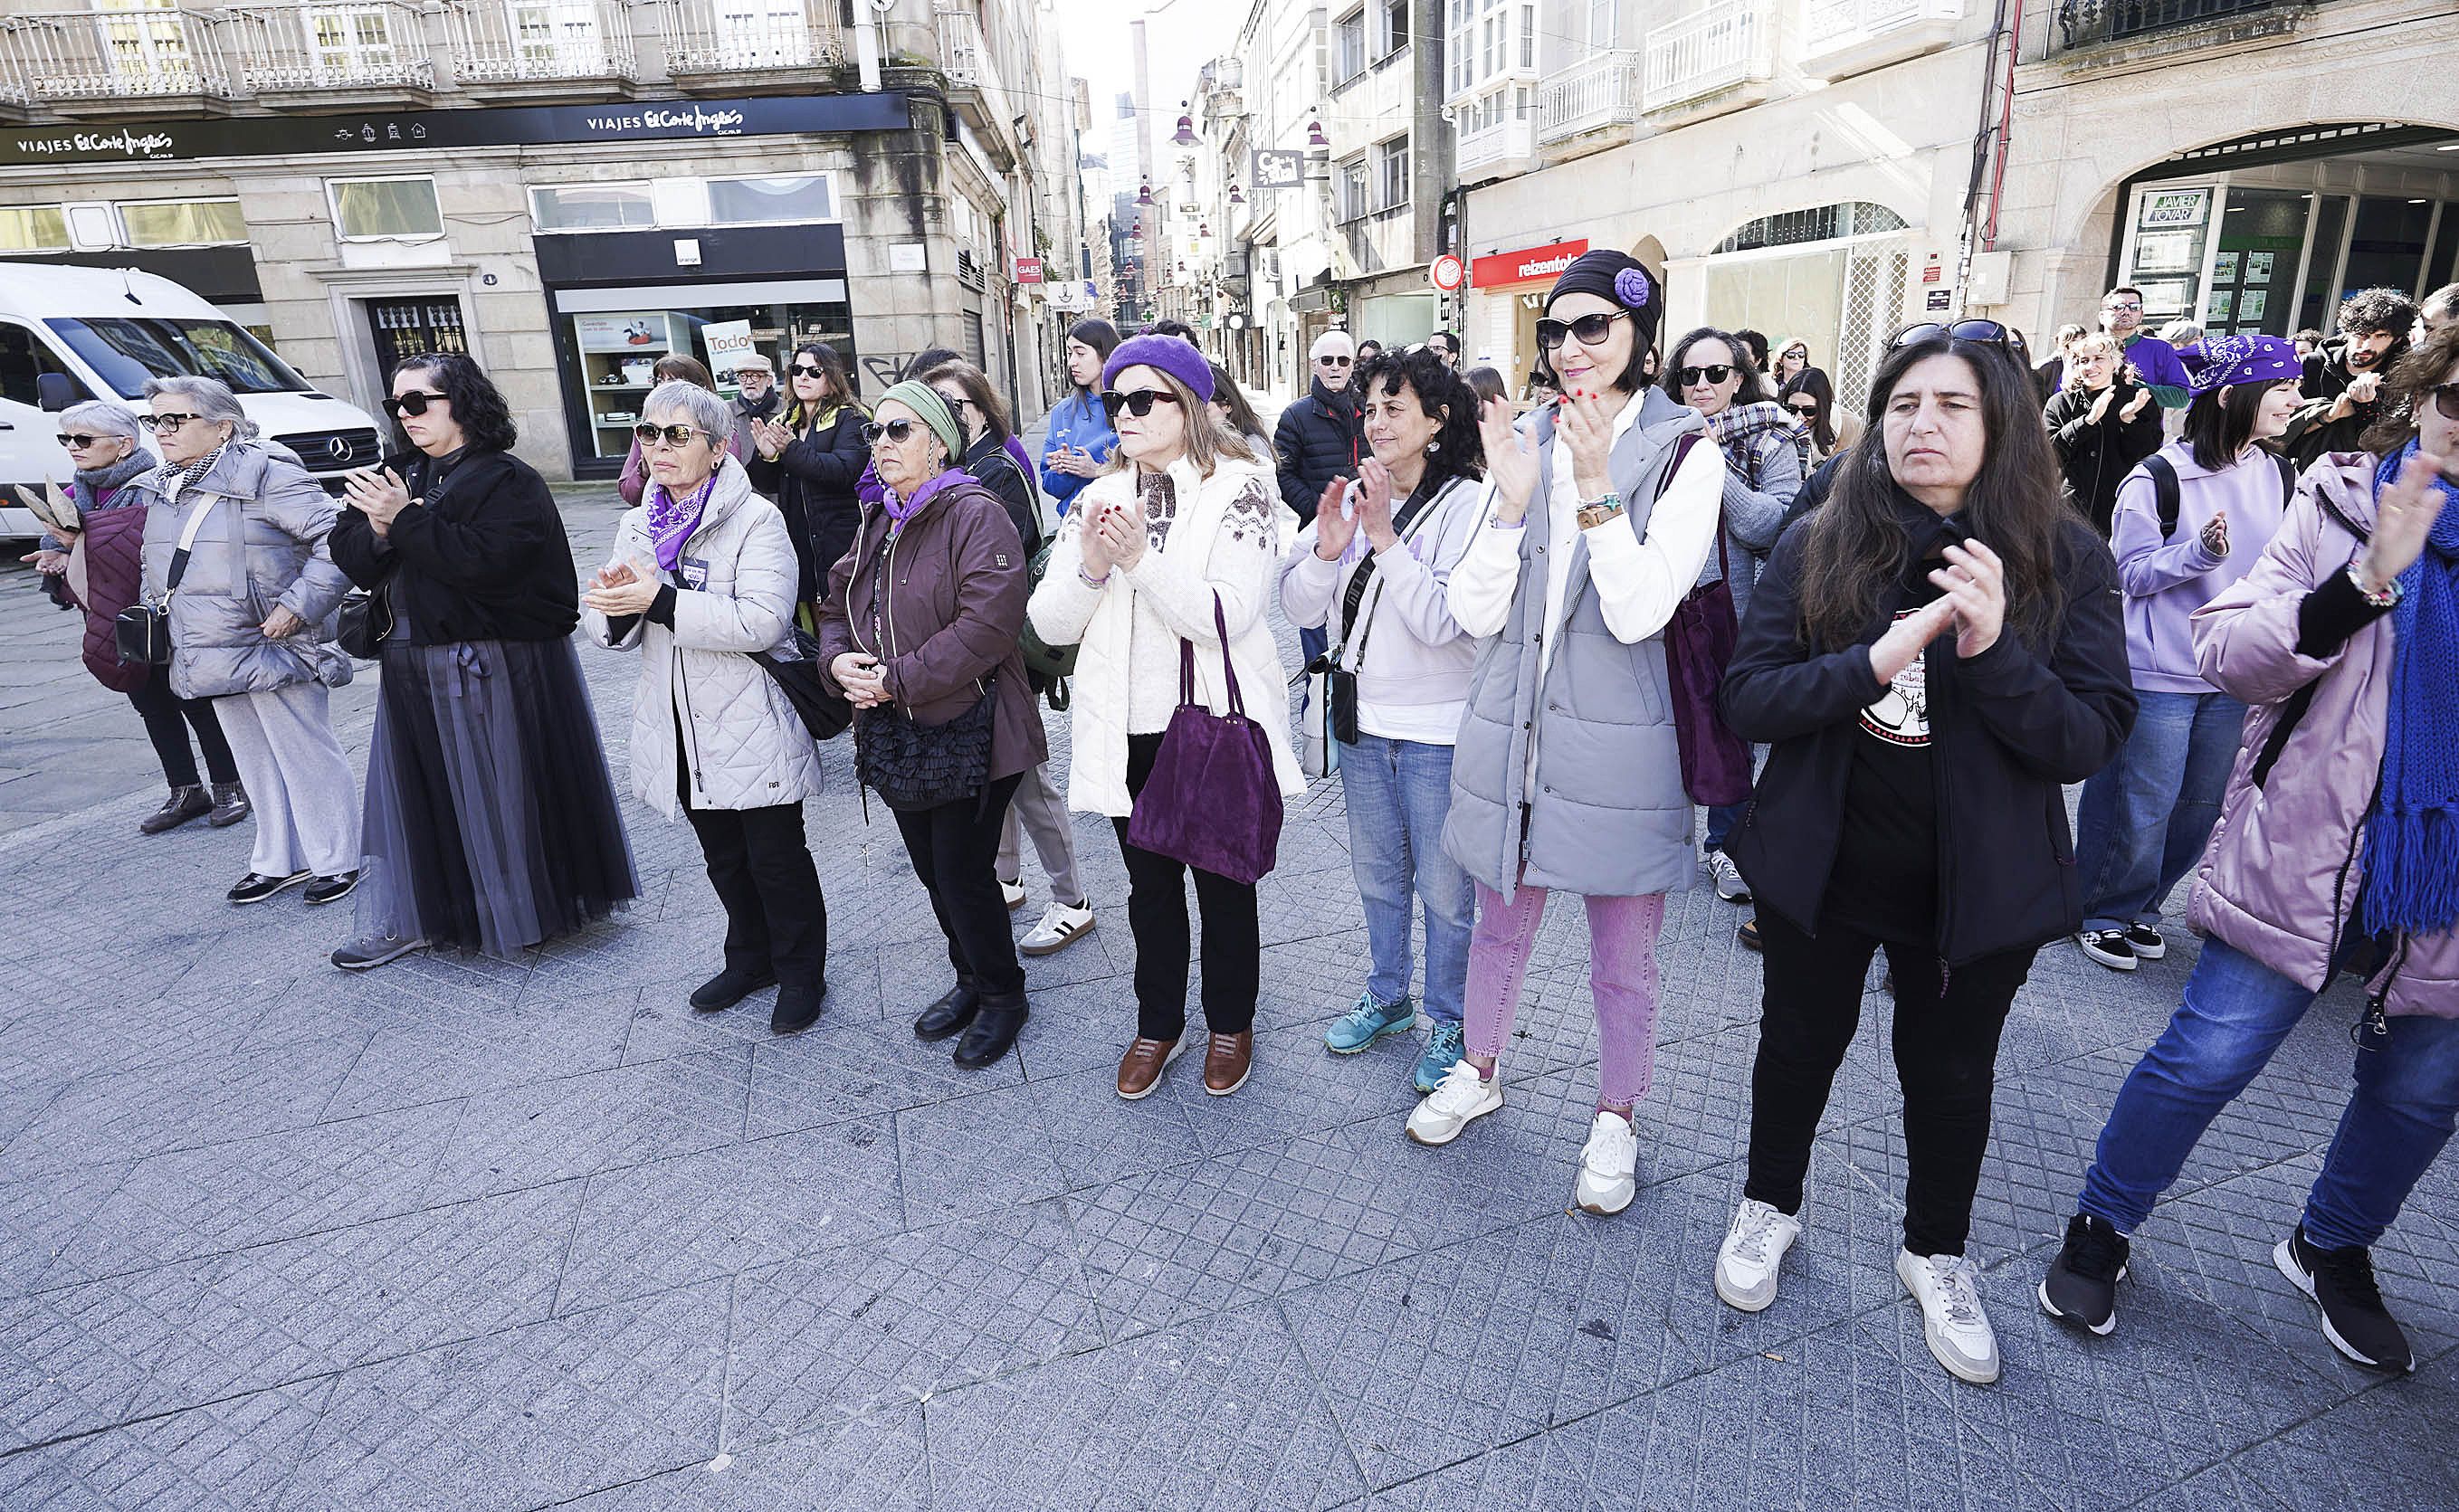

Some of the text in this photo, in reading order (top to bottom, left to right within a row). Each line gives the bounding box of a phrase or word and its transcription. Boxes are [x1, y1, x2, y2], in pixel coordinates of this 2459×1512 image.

[586, 116, 643, 132] VIAJES
[17, 138, 72, 155] VIAJES
[2159, 195, 2196, 208] JAVIER
[2154, 209, 2189, 221] TOVAR
[1017, 265, 1041, 274] GAES
[1518, 252, 1579, 278] reizentol
[708, 333, 748, 351] Todo
